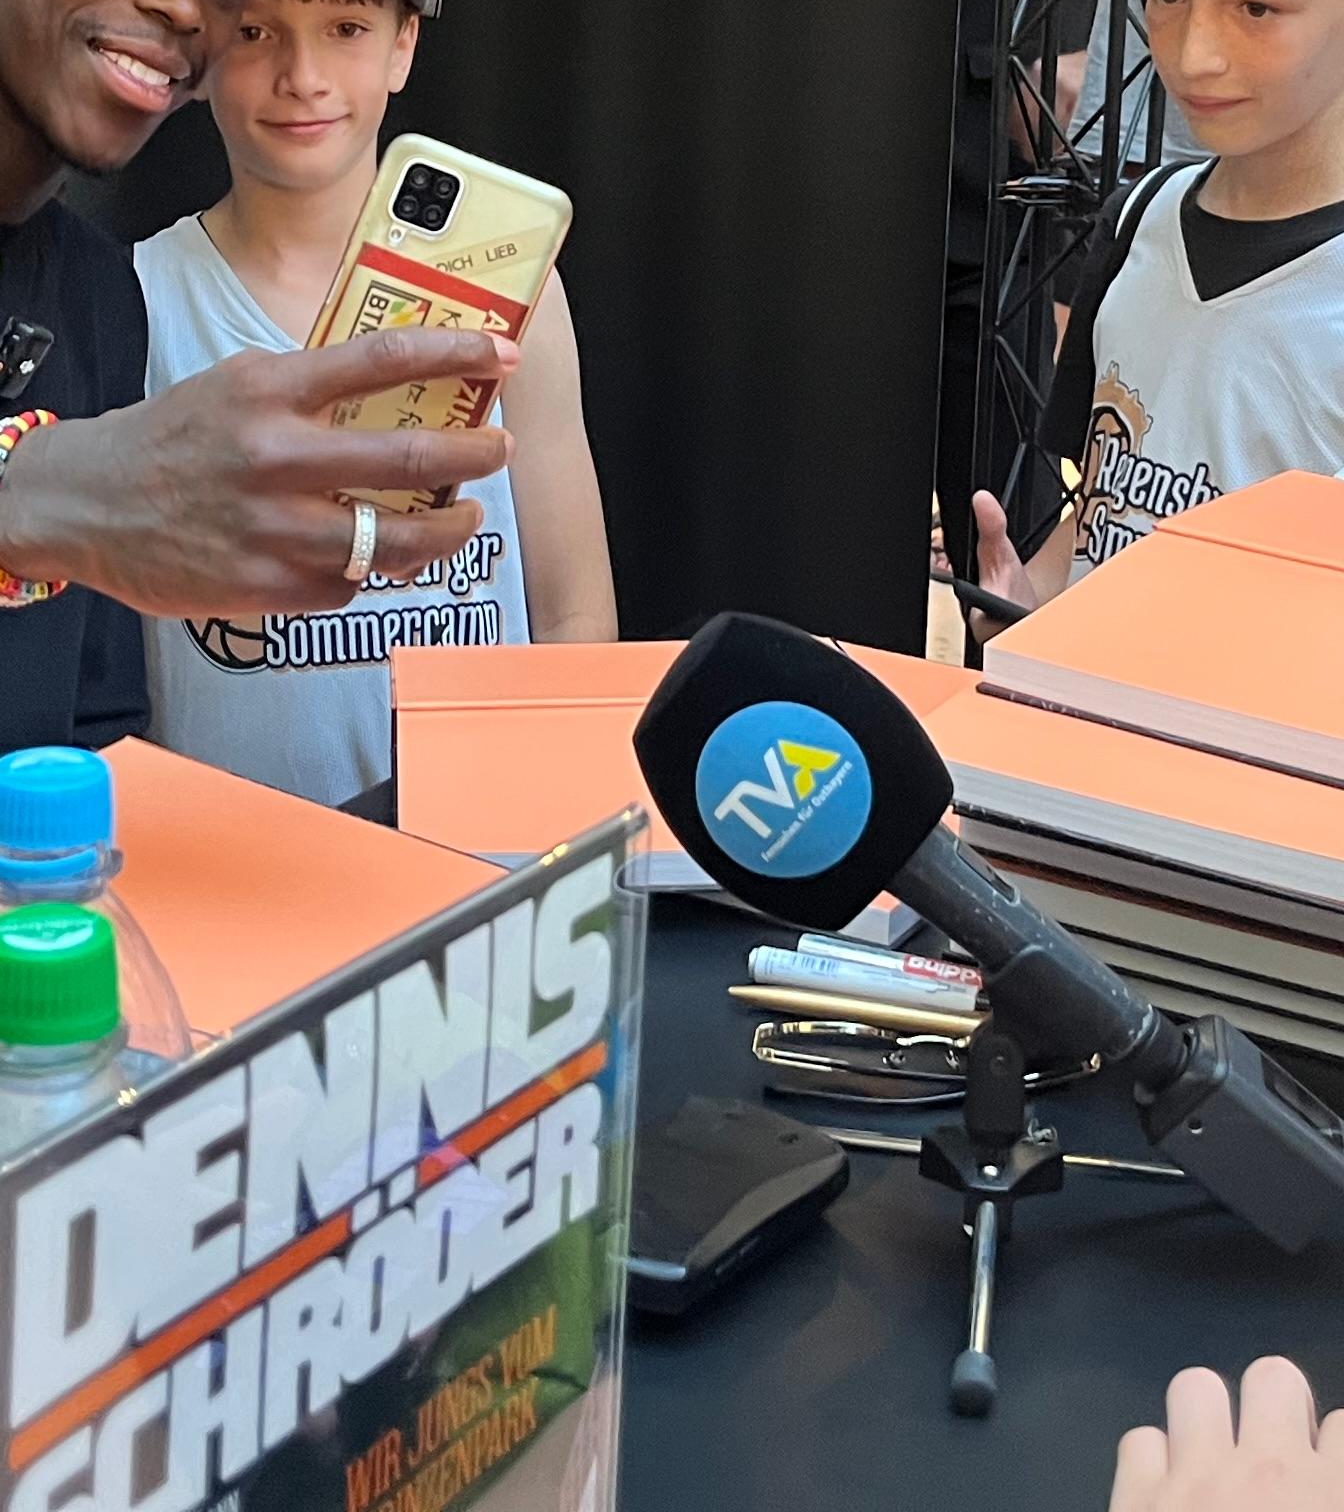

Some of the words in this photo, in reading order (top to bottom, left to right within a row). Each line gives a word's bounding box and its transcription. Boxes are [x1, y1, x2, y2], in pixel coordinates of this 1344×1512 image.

[485, 243, 519, 263] LIEB
[714, 738, 841, 840] TVA
[908, 956, 984, 989] dding
[8, 852, 615, 1429] DENNIS
[346, 1426, 402, 1512] WIR
